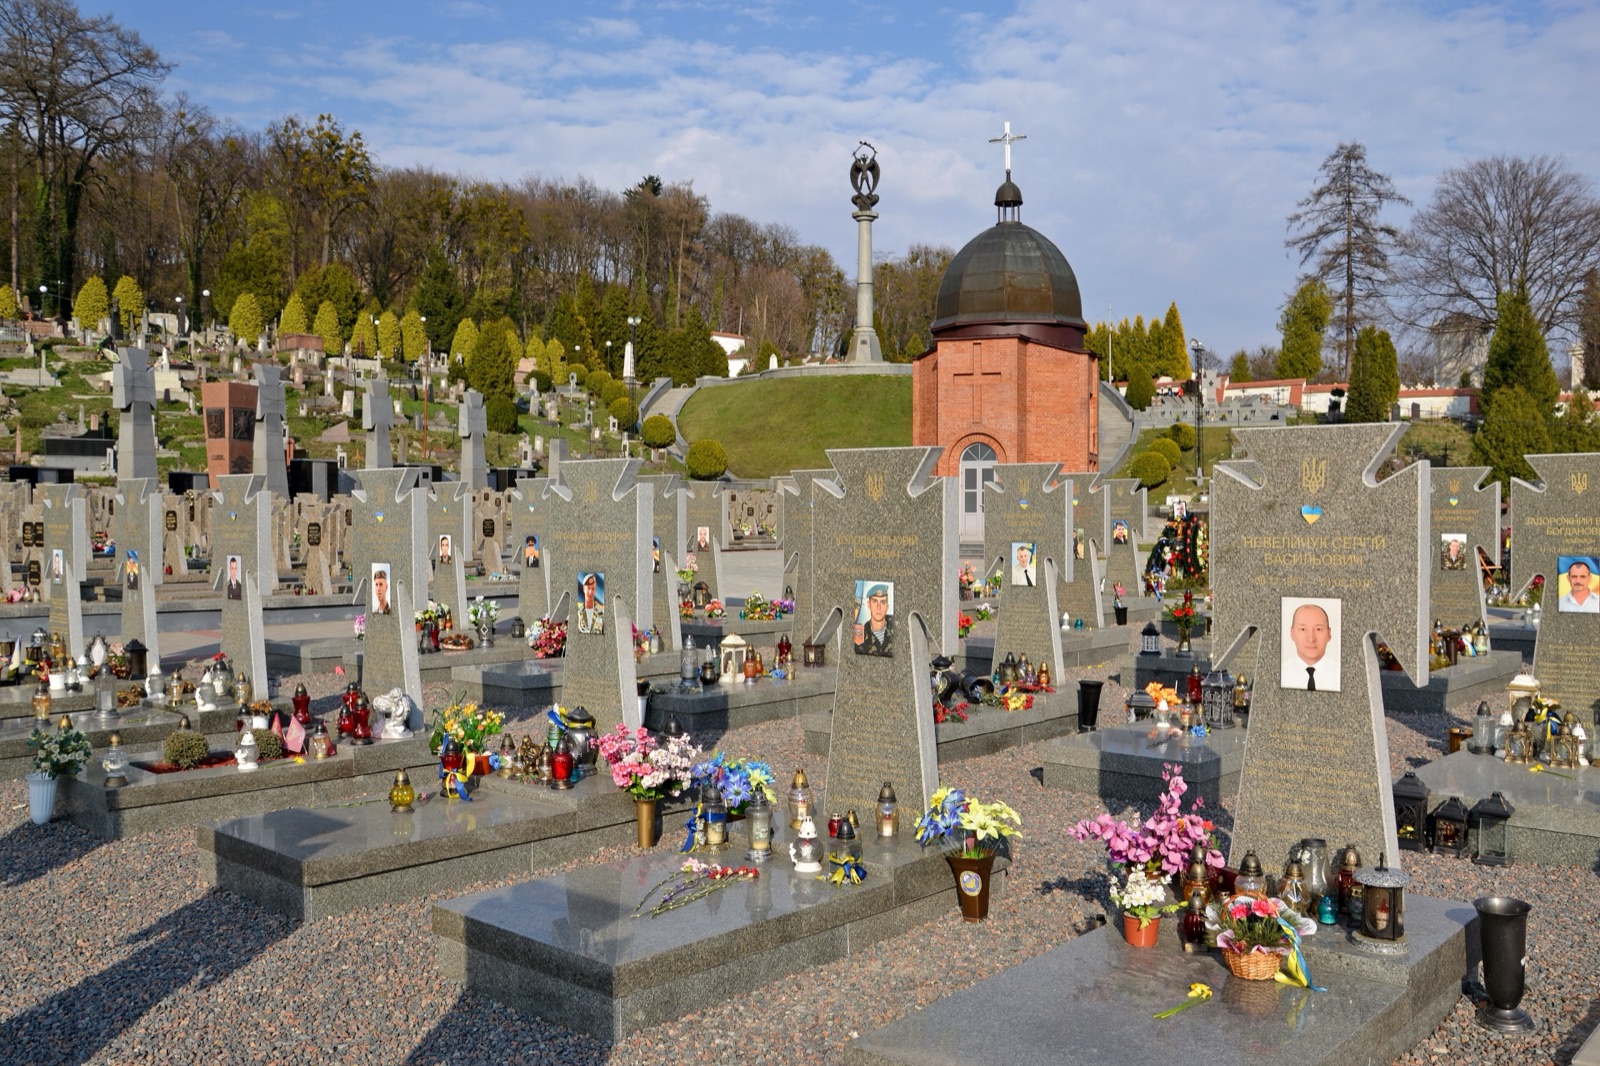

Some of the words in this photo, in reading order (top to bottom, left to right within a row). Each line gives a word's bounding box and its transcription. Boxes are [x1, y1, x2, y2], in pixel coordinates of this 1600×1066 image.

[1525, 516, 1593, 526] ЗАДОРОЖНИЙ
[1546, 527, 1600, 536] БОГДАНОВ
[1243, 536, 1328, 549] НЕВЕЛИЧУК
[1332, 535, 1386, 549] СЕРГІЙ
[853, 548, 900, 559] ІВАНОВИЧ
[1263, 553, 1364, 566] ВАСИЛЬОВИЧ
